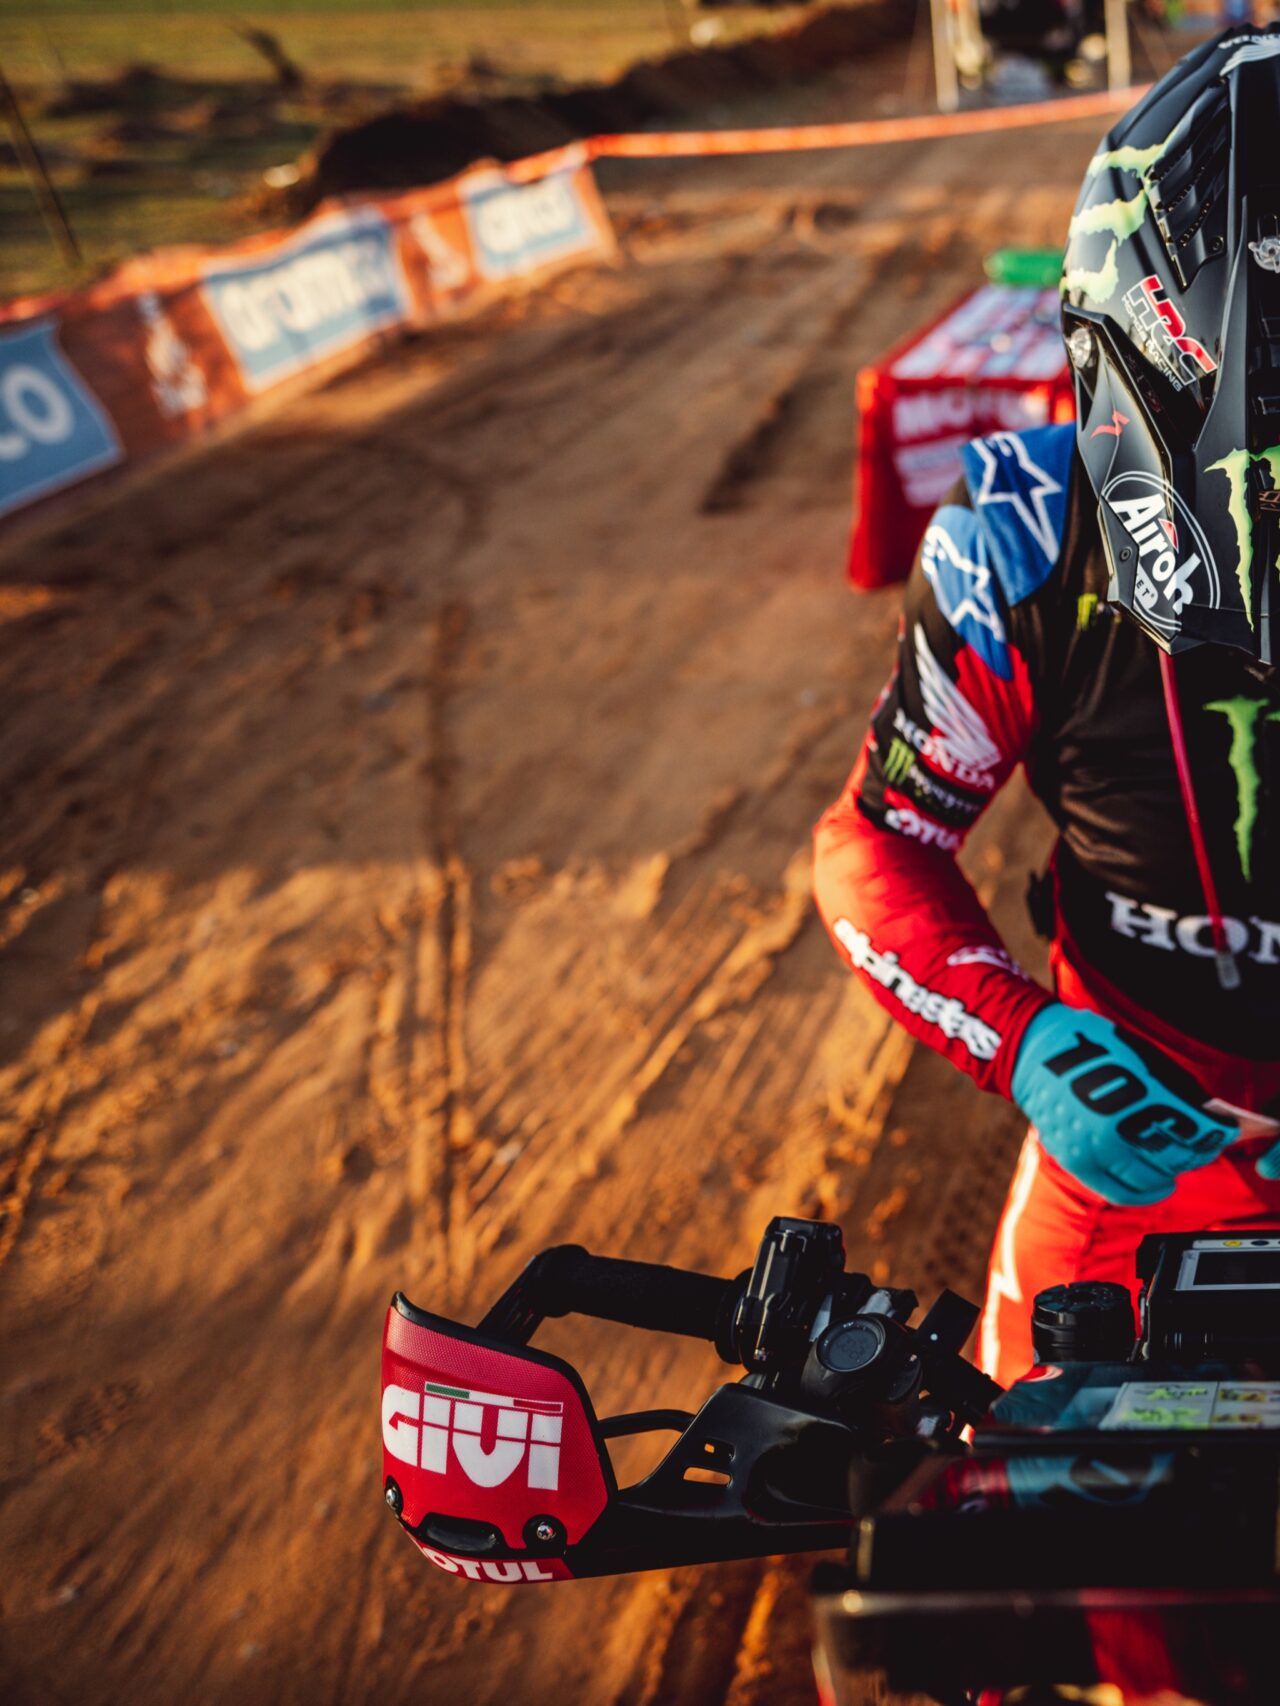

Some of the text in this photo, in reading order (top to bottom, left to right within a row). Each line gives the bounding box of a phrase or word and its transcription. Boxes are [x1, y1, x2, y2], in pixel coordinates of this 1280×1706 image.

[1126, 274, 1217, 385] HRC
[1109, 493, 1201, 615] Airoh
[893, 707, 995, 790] HONDA
[382, 1384, 563, 1491] GIVI
[418, 1546, 553, 1582] OTUL
